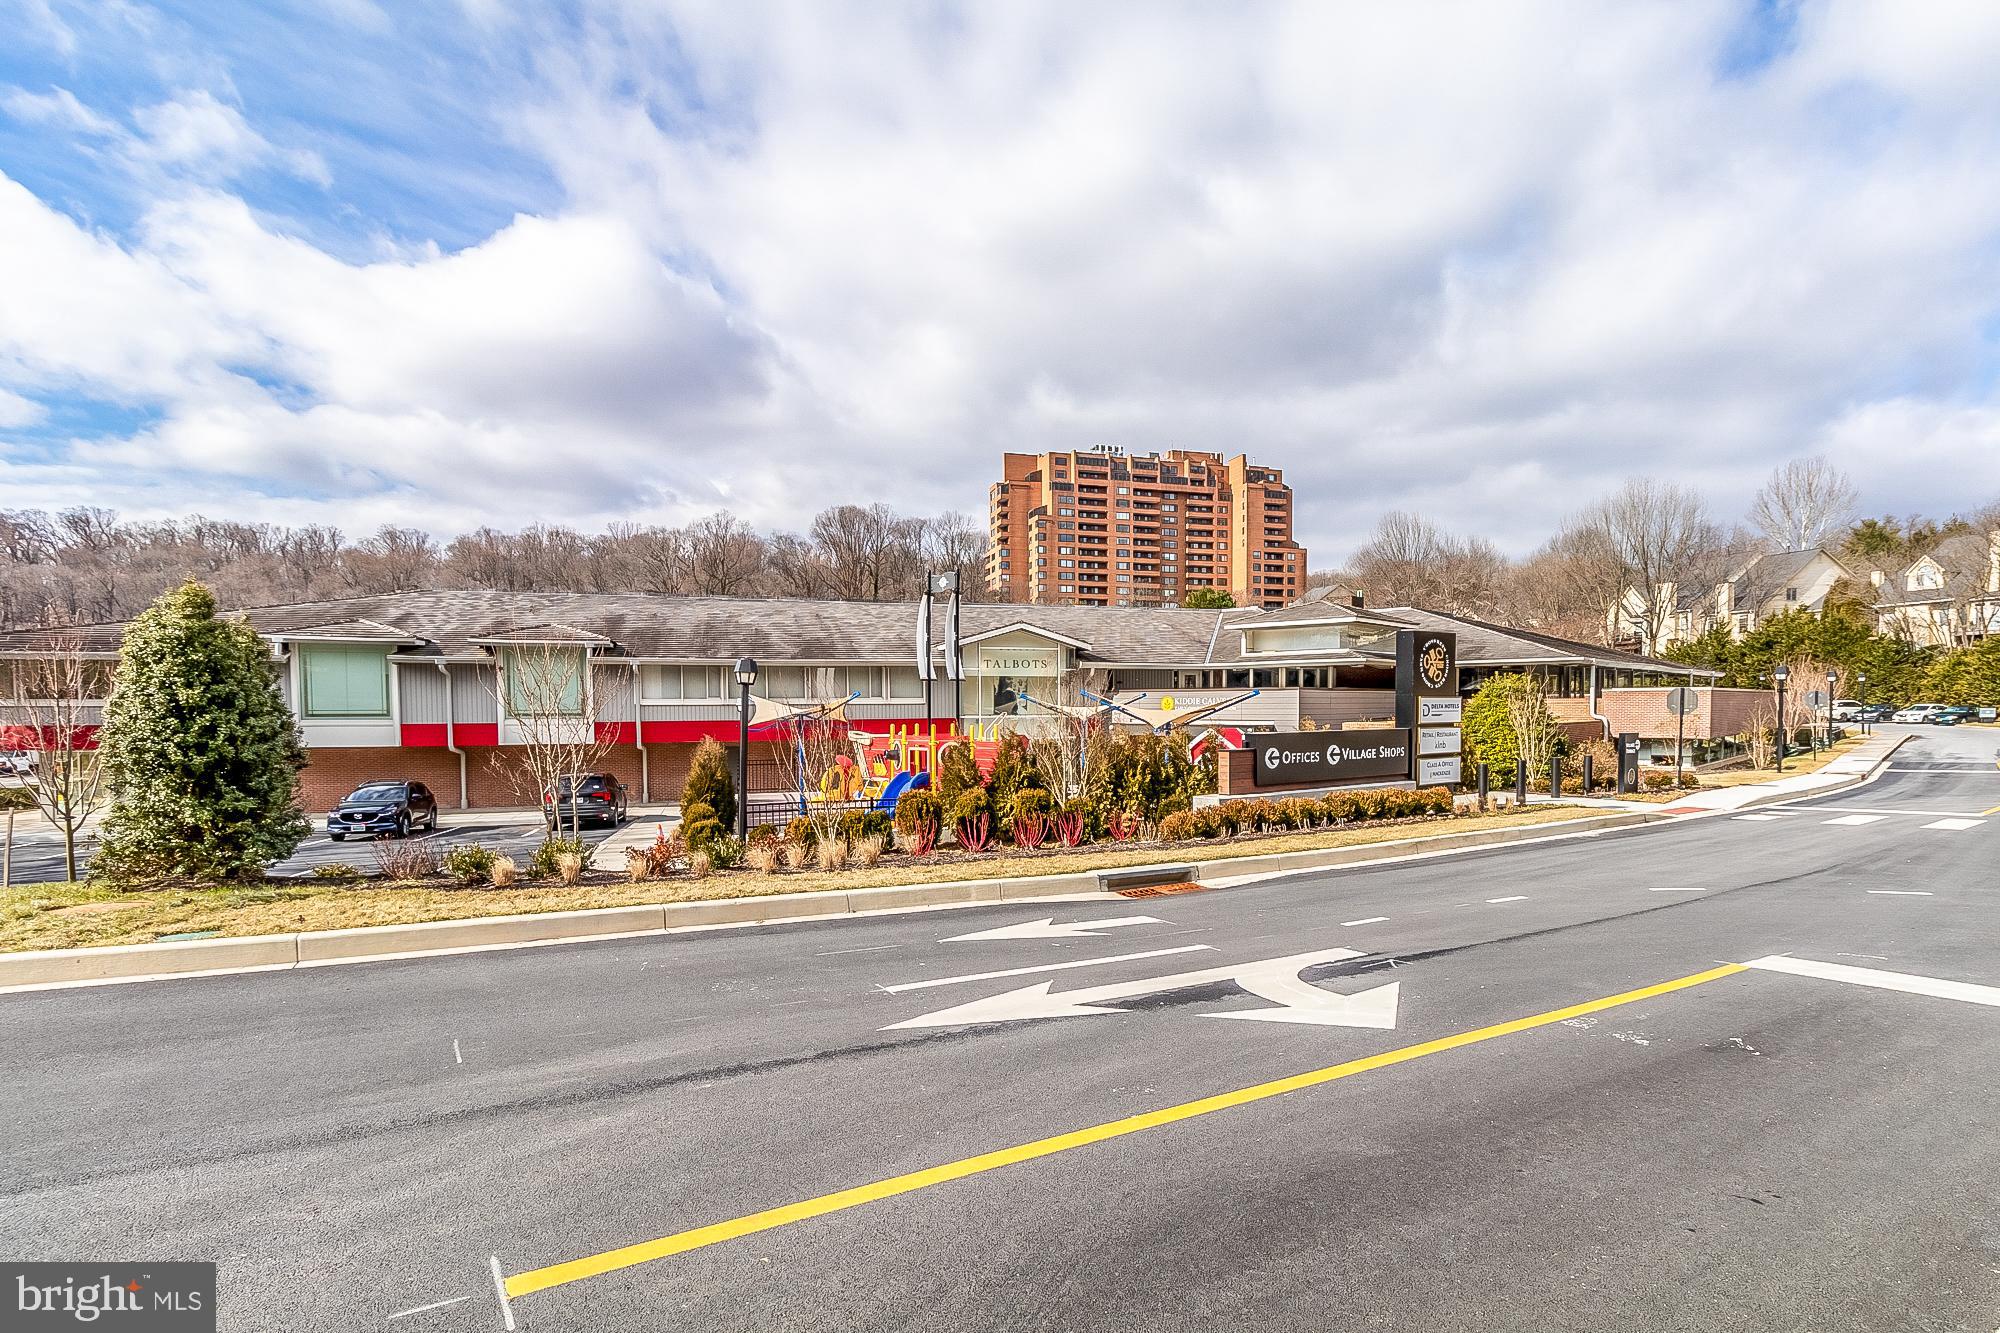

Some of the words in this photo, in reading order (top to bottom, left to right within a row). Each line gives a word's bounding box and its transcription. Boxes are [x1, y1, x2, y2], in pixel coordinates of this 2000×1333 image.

[984, 660, 1048, 668] TALBOTS
[1174, 697, 1200, 705] KIDDIE
[1282, 750, 1320, 764] OFFICES
[1342, 748, 1376, 760] VILLAGE
[1379, 746, 1405, 758] SHOPS
